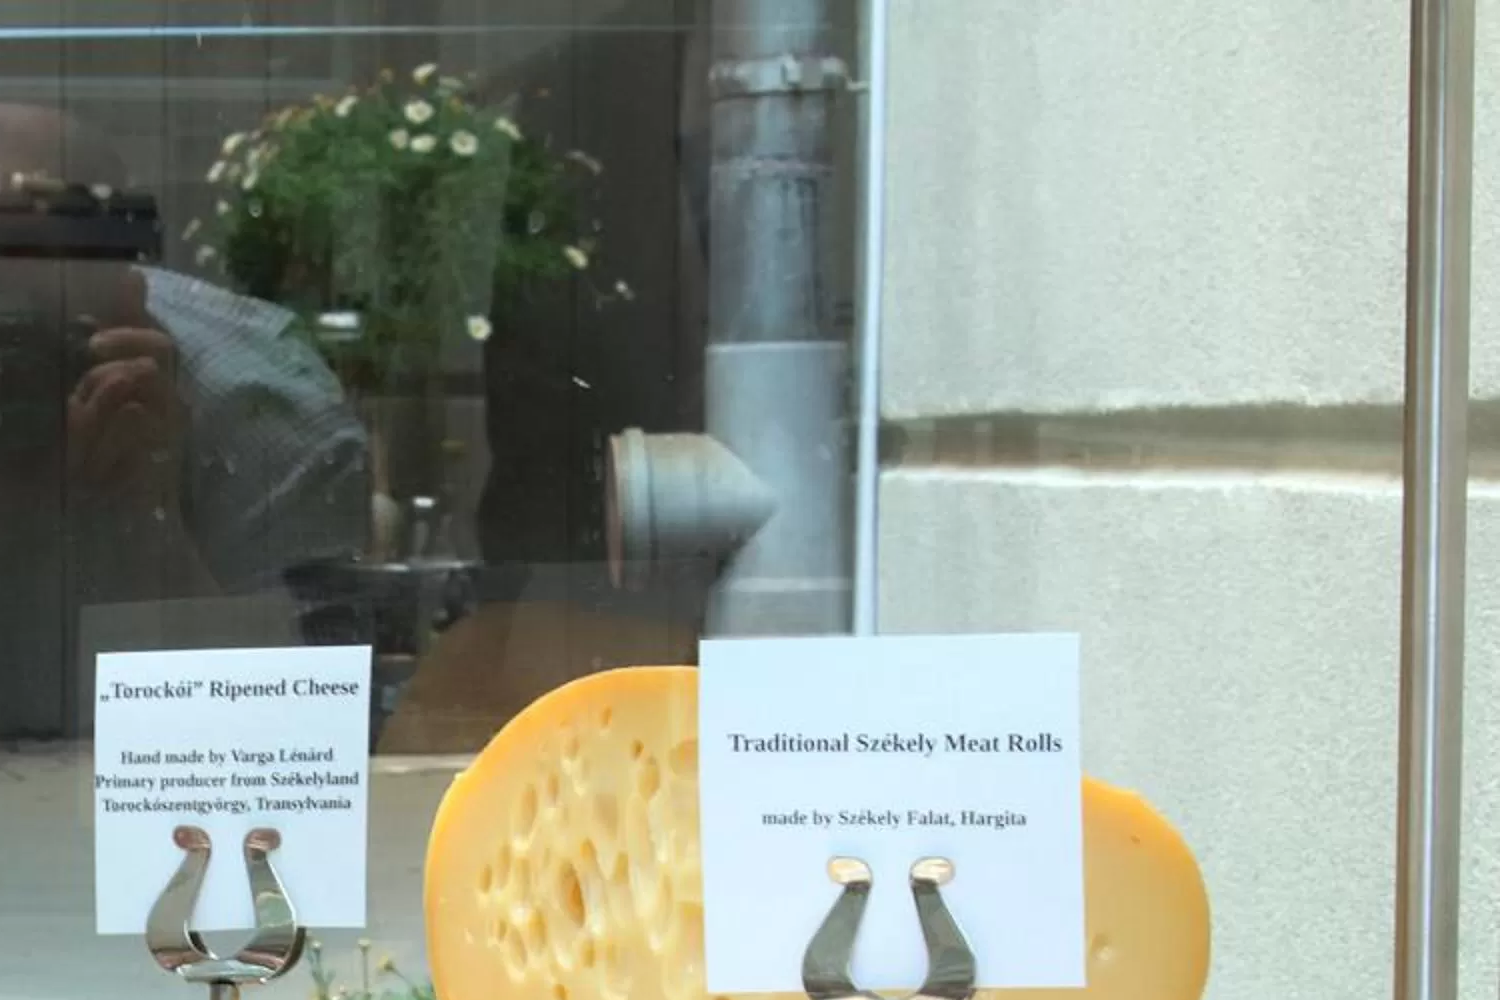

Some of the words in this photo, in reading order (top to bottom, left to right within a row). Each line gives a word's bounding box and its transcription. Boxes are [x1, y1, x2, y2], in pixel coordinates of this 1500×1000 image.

[209, 679, 286, 701] Ripened
[292, 677, 359, 697] Cheese
[727, 733, 849, 752] Traditional
[855, 732, 935, 758] Székely
[944, 733, 1000, 753] Meat
[1008, 732, 1063, 753] Rolls
[121, 751, 160, 765] Hand
[165, 749, 204, 764] made
[209, 748, 226, 767] by
[231, 749, 275, 765] Varga
[95, 774, 155, 791] Primary
[160, 773, 227, 790] producer
[230, 772, 266, 787] from
[270, 771, 359, 789] Székelyland
[256, 796, 352, 814] Transylvania
[761, 809, 808, 825] made
[813, 809, 832, 828] by
[838, 809, 900, 829] Székely
[907, 809, 956, 827] Falat,
[960, 809, 1027, 830] Hargita
